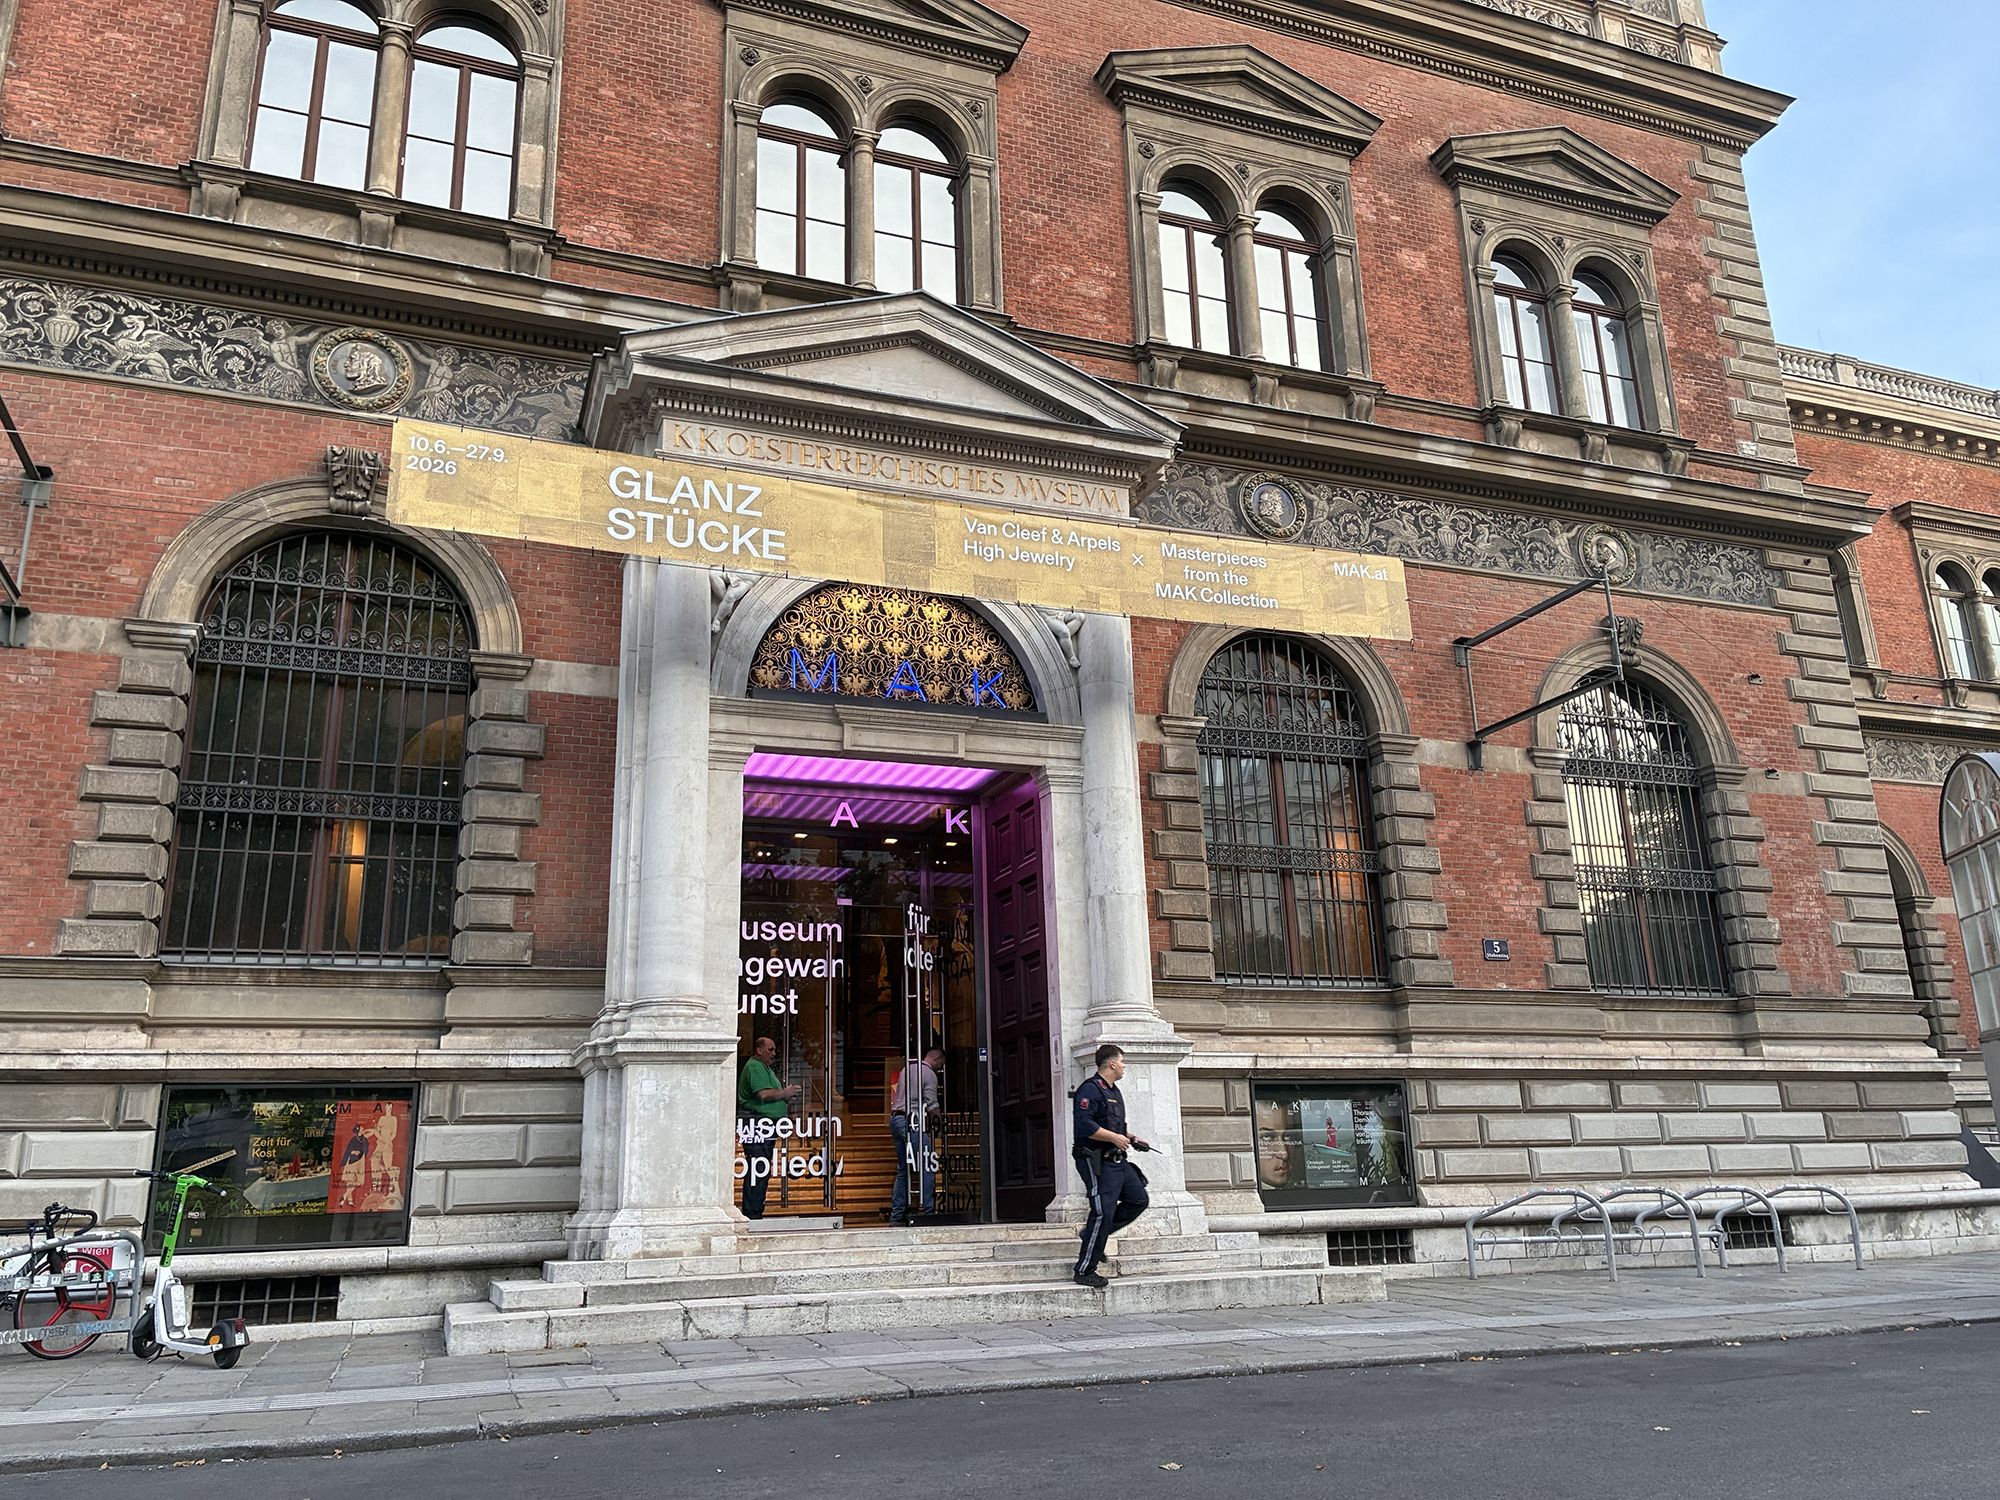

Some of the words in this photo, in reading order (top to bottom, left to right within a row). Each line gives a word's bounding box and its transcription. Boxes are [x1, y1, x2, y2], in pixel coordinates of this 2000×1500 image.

[406, 455, 457, 475] 2026
[674, 424, 693, 449] K
[699, 428, 719, 453] K
[726, 432, 1005, 496] OESTERREICHISCHES
[1014, 475, 1122, 513] MVSEVM
[608, 466, 763, 518] GLANZ
[607, 508, 787, 561] STÜCKE
[964, 517, 998, 536] Van
[1002, 522, 1048, 543] Cleef
[1051, 528, 1064, 544] &
[1067, 531, 1121, 552] Arpels
[964, 539, 1004, 562] High
[1009, 547, 1075, 572] Jewelry
[1161, 542, 1268, 568] Masterpieces
[1184, 565, 1220, 582] from
[1223, 570, 1248, 586] the
[1333, 562, 1388, 581] MAK.at
[1154, 583, 1198, 602] MAK
[1200, 588, 1279, 610] Collection
[741, 921, 842, 942] useum
[907, 902, 931, 934] für
[1493, 941, 1500, 953] 5
[737, 989, 798, 1014] unst
[737, 1117, 842, 1138] useum
[252, 1148, 277, 1158] Kost
[253, 1136, 274, 1147] Zeit
[276, 1136, 291, 1147] für
[253, 1209, 283, 1217] September
